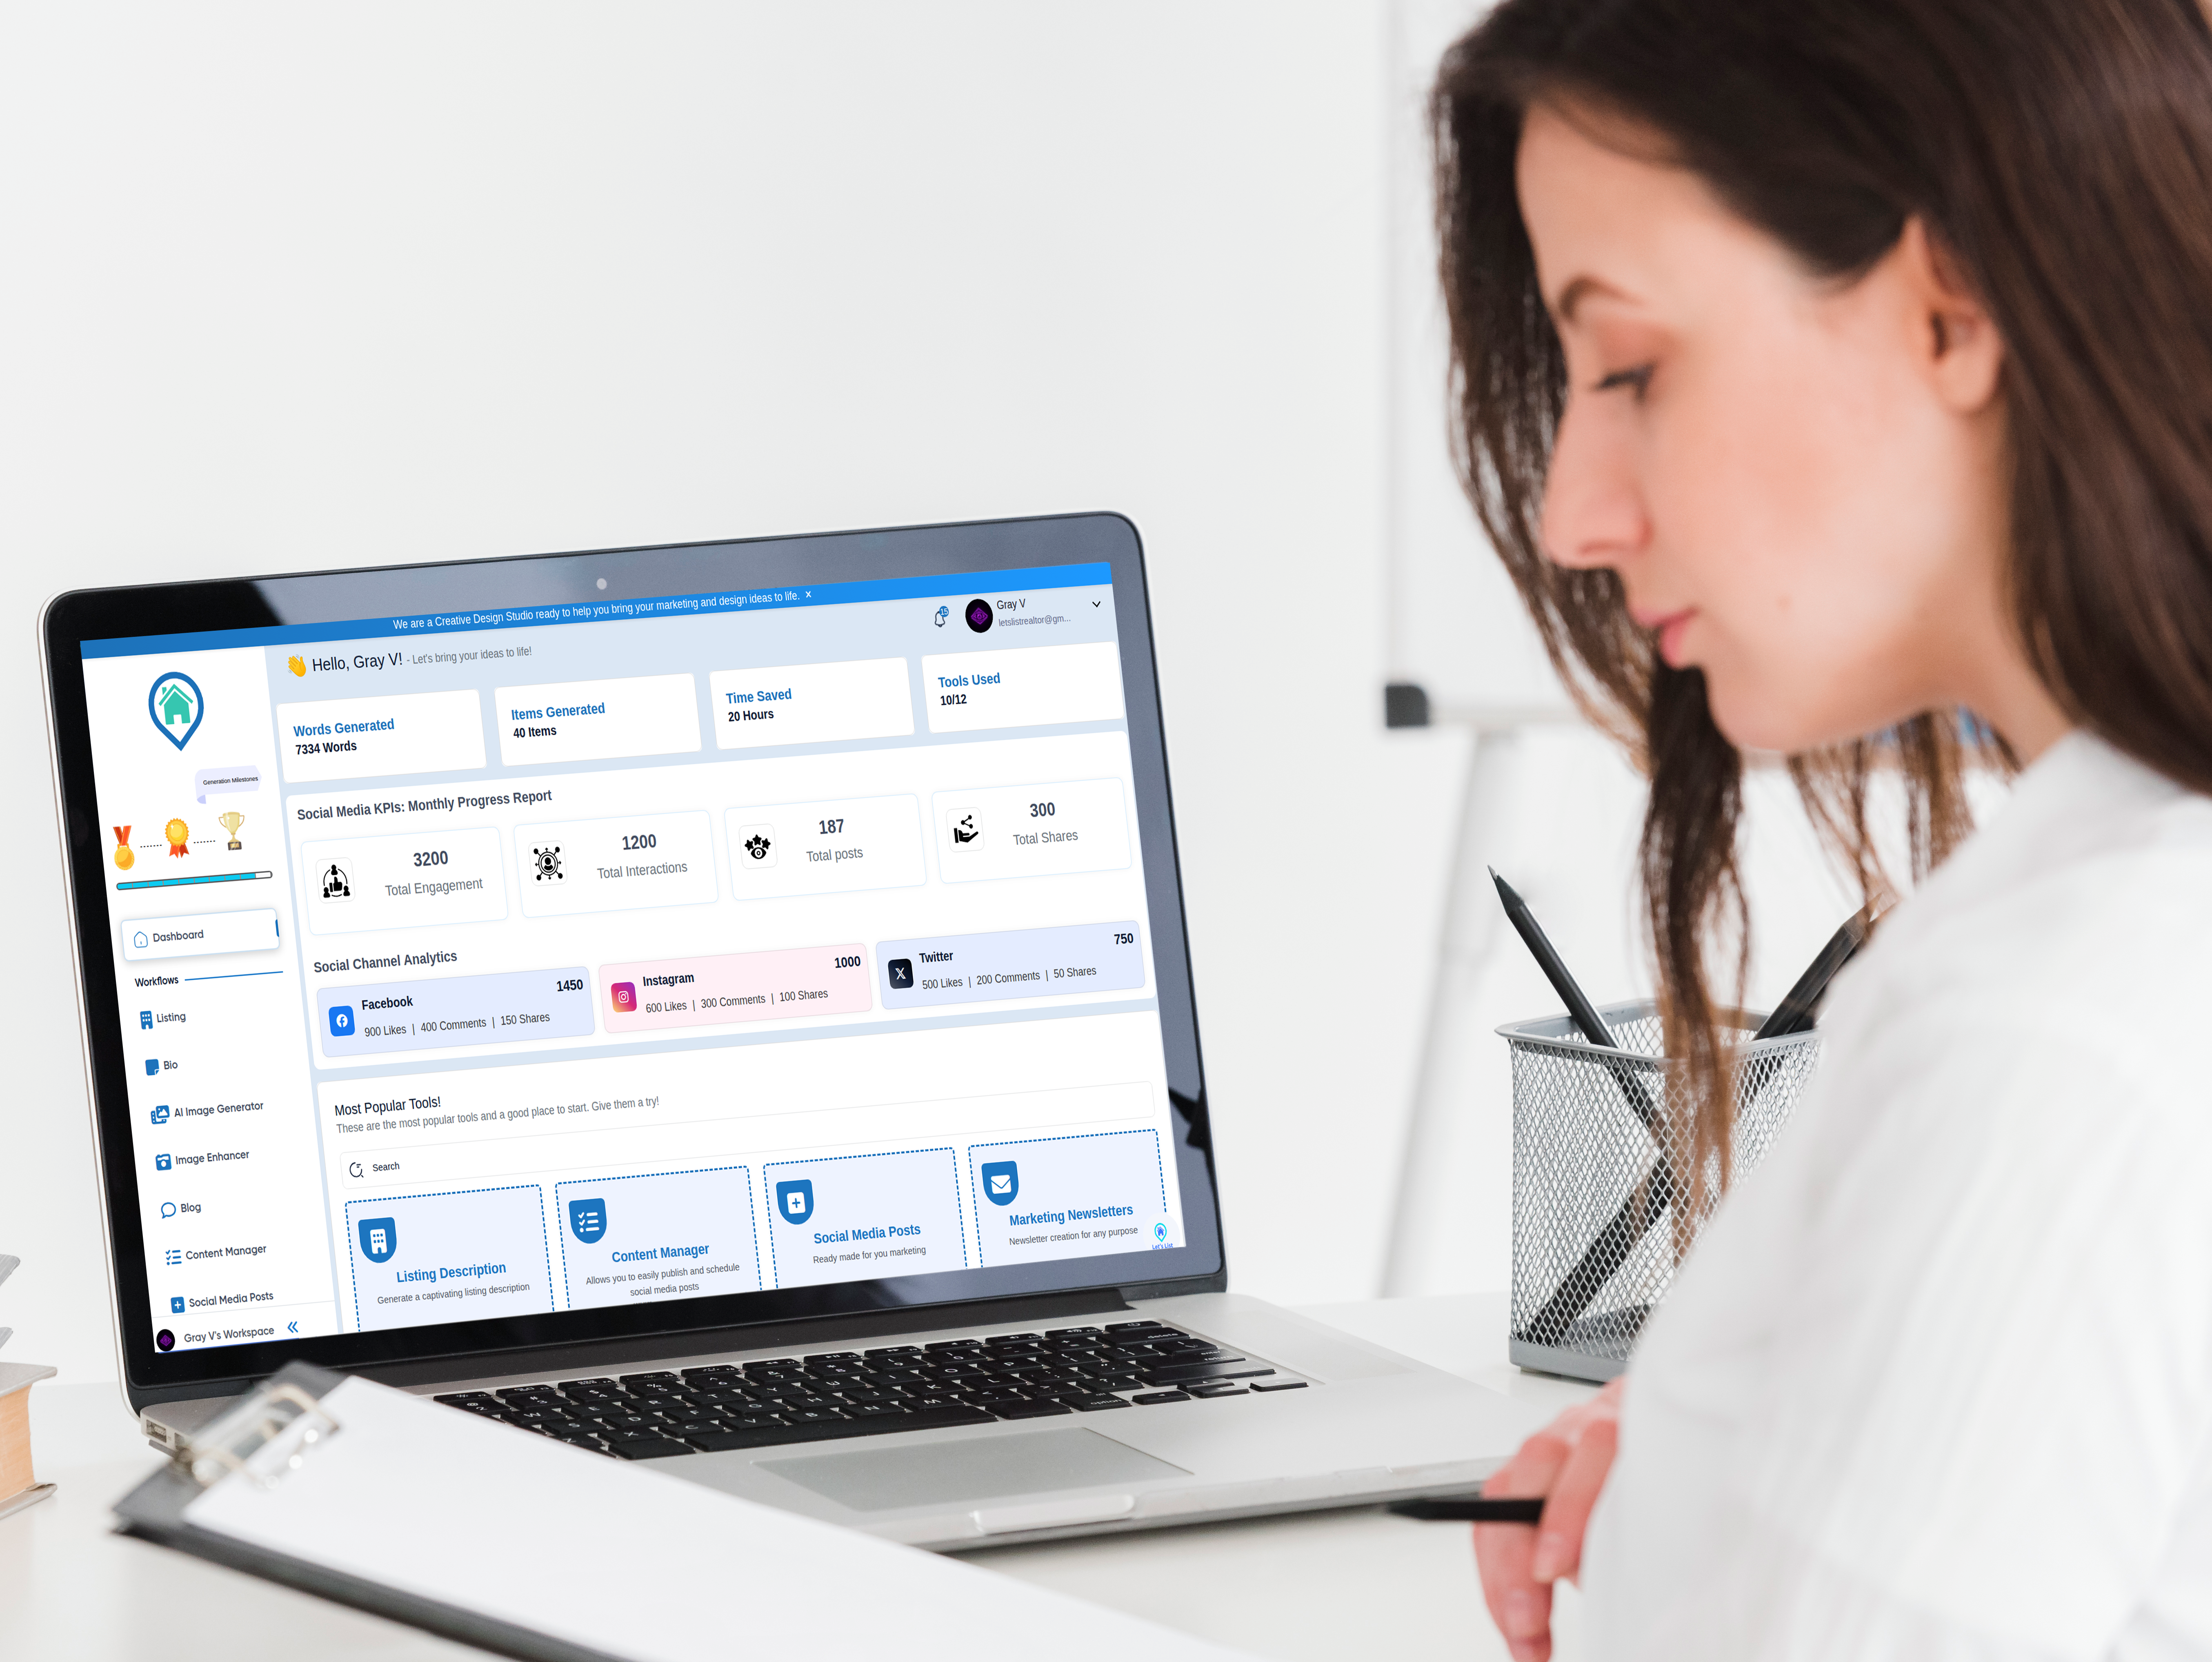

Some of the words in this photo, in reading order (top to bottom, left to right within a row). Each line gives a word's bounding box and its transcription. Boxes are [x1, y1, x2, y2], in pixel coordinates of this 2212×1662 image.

[435, 615, 471, 626] Creative
[473, 612, 503, 625] Design
[506, 610, 533, 621] Studio
[536, 608, 560, 620] ready
[572, 606, 591, 618] help
[611, 603, 633, 615] bring
[635, 603, 654, 614] your
[656, 598, 698, 610] marketing
[719, 595, 747, 607] design
[749, 593, 772, 603] ideas
[785, 591, 800, 601] life.
[996, 600, 1017, 611] Gray
[1018, 598, 1025, 607] V
[998, 614, 1071, 627] letslistrealtor@gm...
[312, 656, 349, 671] Hello,
[353, 655, 385, 670] Gray
[388, 652, 402, 665] V!
[412, 653, 433, 664] Let's
[435, 652, 457, 664] bring
[458, 652, 478, 663] your
[480, 649, 504, 659] ideas
[516, 646, 531, 656] life!
[937, 675, 969, 687] Tools
[972, 672, 1000, 685] Used
[725, 692, 754, 704] Time
[757, 687, 791, 701] Saved
[940, 694, 967, 705] 10/12
[511, 709, 543, 720] Items
[546, 702, 605, 717] Generated
[728, 711, 740, 722] 20
[743, 710, 774, 721] Hours
[293, 723, 331, 736] Words
[334, 718, 394, 733] Generated
[513, 728, 525, 738] 40
[528, 727, 557, 737] Items
[295, 743, 320, 755] 7334
[322, 740, 357, 752] Words
[297, 806, 333, 820] Social
[336, 803, 371, 817] Media
[373, 802, 405, 814] KPIs:
[408, 797, 454, 812] Monthly
[457, 795, 510, 809] Progress
[513, 790, 552, 805] Report
[1029, 802, 1055, 817] 300
[819, 818, 844, 834] 187
[622, 834, 656, 850] 1200
[1012, 832, 1038, 845] Total
[1041, 831, 1078, 843] Shares
[413, 850, 448, 867] 3200
[806, 849, 831, 862] Total
[835, 848, 863, 863] posts
[596, 865, 622, 879] Total
[626, 862, 687, 877] Interactions
[385, 883, 411, 896] Total
[414, 878, 483, 896] Engagement
[153, 929, 204, 942] Dashboard
[1114, 932, 1134, 944] 750
[313, 959, 349, 972] Social
[353, 954, 400, 969] Channel
[404, 950, 457, 966] Analytics
[834, 956, 860, 968] 1000
[918, 951, 953, 963] Twitter
[134, 976, 178, 987] Workflows
[556, 979, 583, 992] 1450
[642, 974, 694, 987] Instagram
[922, 979, 938, 989] 500
[940, 978, 963, 988] Likes
[976, 974, 992, 985] 200
[994, 971, 1040, 983] Comments
[1054, 968, 1064, 978] 50
[1067, 967, 1096, 977] Shares
[361, 995, 413, 1010] Facebook
[646, 1002, 662, 1013] 600
[664, 1001, 687, 1011] Likes
[700, 997, 717, 1008] 300
[719, 995, 765, 1006] Comments
[779, 991, 796, 1001] 100
[798, 990, 828, 1000] Shares
[156, 1012, 186, 1023] Listing
[364, 1026, 381, 1037] 900
[383, 1025, 407, 1035] Likes
[420, 1021, 437, 1032] 400
[439, 1018, 487, 1030] Comments
[500, 1015, 517, 1025] 150
[519, 1014, 550, 1023] Shares
[163, 1060, 178, 1070] Bio
[174, 1107, 183, 1117] AI
[185, 1107, 214, 1117] Image
[216, 1102, 263, 1113] Generator
[334, 1103, 362, 1116] Most
[364, 1099, 406, 1115] Popular
[408, 1096, 440, 1109] Tools!
[336, 1123, 363, 1133] These
[399, 1117, 420, 1128] most
[422, 1114, 455, 1128] popular
[457, 1112, 478, 1123] tools
[507, 1107, 529, 1121] good
[531, 1106, 554, 1119] place
[567, 1103, 589, 1113] start.
[175, 1155, 205, 1165] Image
[207, 1151, 249, 1162] Enhancer
[372, 1161, 400, 1172] Search
[180, 1202, 201, 1213] Blog
[1009, 1211, 1065, 1226] Marketing
[1067, 1206, 1133, 1220] Newsletters
[814, 1229, 849, 1244] Social
[851, 1227, 886, 1240] Media
[888, 1224, 920, 1237] Posts
[1009, 1235, 1048, 1245] Newsletter
[1050, 1231, 1079, 1241] creation
[1108, 1227, 1138, 1238] purpose
[185, 1248, 223, 1259] Content
[225, 1246, 267, 1256] Manager
[611, 1248, 658, 1262] Content
[660, 1245, 709, 1259] Manager
[813, 1254, 837, 1264] Ready
[839, 1252, 860, 1261] made
[889, 1246, 926, 1256] marketing
[396, 1269, 436, 1283] Listing
[439, 1262, 506, 1279] Description
[586, 1276, 610, 1285] Allows
[637, 1270, 659, 1280] easily
[661, 1267, 688, 1279] publish
[706, 1263, 740, 1273] schedule
[377, 1294, 413, 1304] Generate
[422, 1289, 463, 1301] captivating
[464, 1287, 487, 1296] listing
[489, 1283, 530, 1294] description
[630, 1286, 652, 1296] social
[654, 1284, 677, 1294] media
[678, 1283, 699, 1293] posts
[189, 1295, 217, 1307] Social
[219, 1294, 247, 1304] Media
[249, 1292, 273, 1302] Posts
[184, 1333, 206, 1343] Gray
[208, 1330, 221, 1340] V's
[222, 1327, 274, 1339] Workspace
